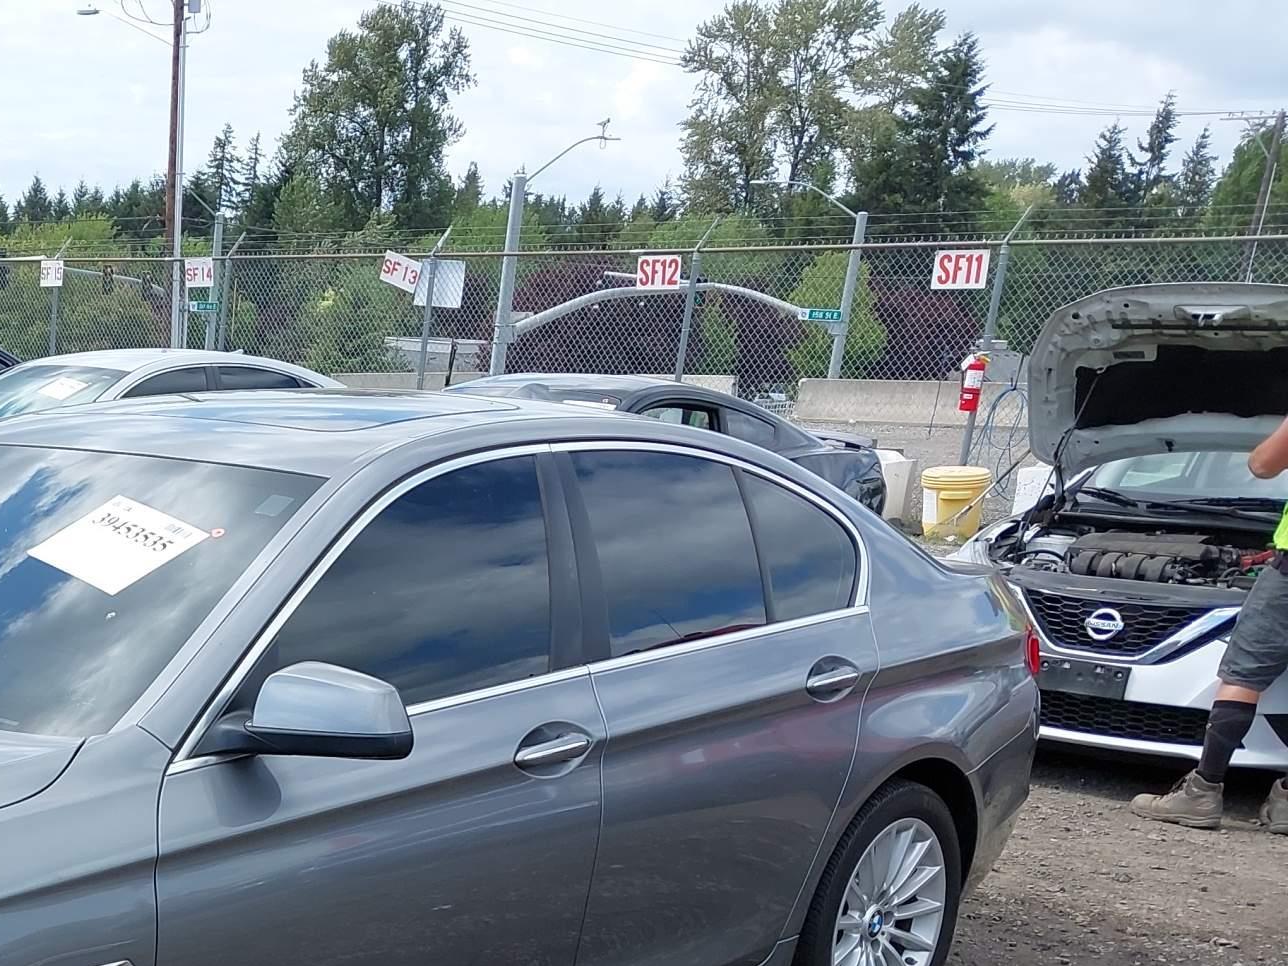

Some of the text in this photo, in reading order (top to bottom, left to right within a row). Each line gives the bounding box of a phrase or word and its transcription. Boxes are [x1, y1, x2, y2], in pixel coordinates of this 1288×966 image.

[639, 258, 679, 286] SF12
[937, 254, 983, 285] SF11
[92, 512, 175, 551] 39453535
